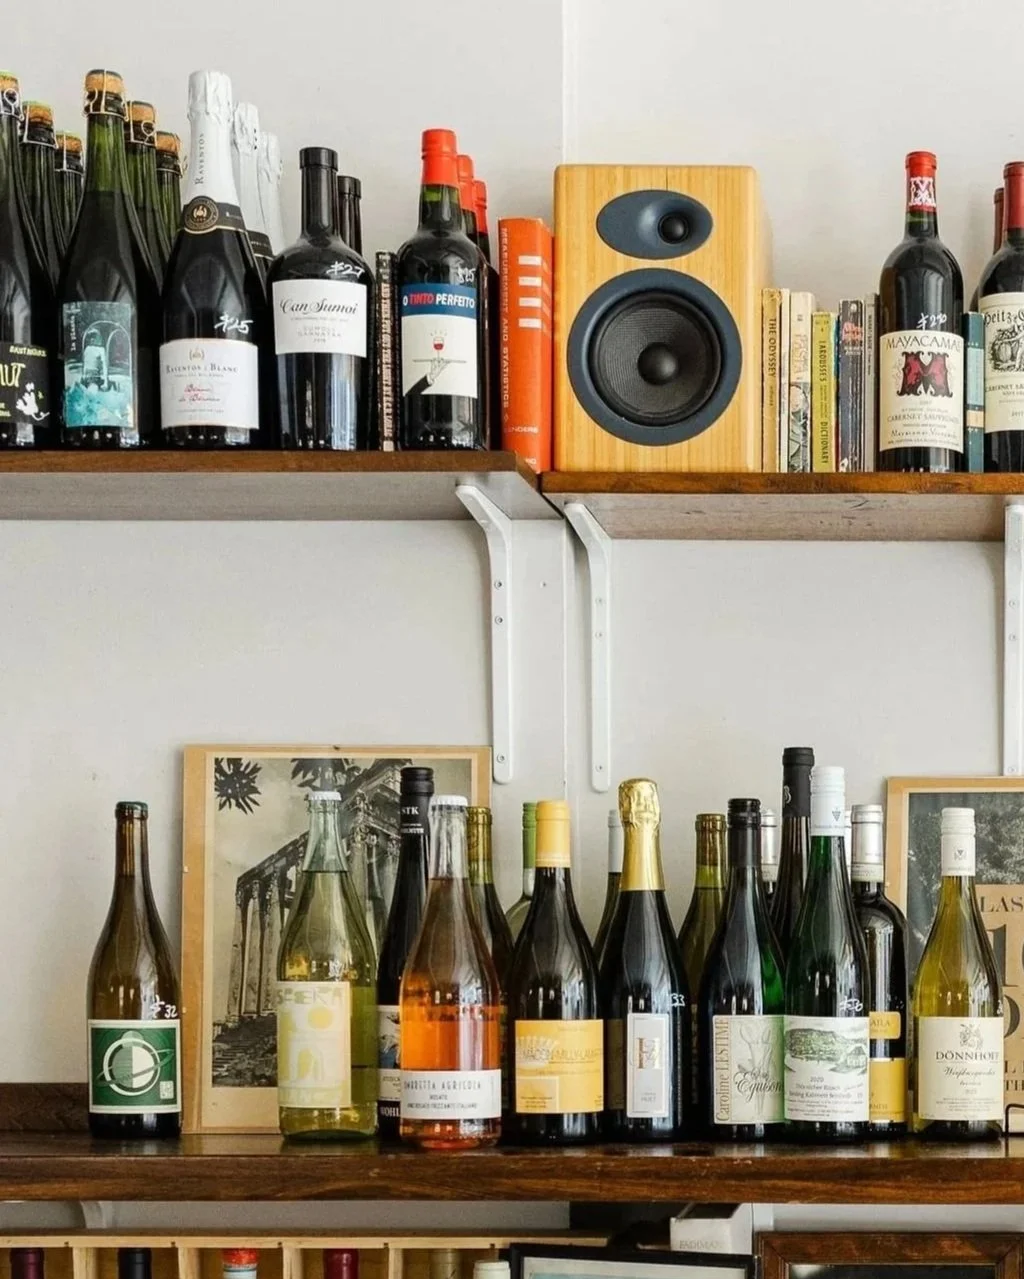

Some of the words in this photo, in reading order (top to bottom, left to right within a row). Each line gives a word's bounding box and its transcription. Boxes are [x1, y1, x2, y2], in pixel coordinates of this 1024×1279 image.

[410, 292, 434, 306] TINTO
[435, 293, 476, 309] PERFEITO
[768, 318, 777, 336] THE
[768, 337, 777, 378] ODYSSEY
